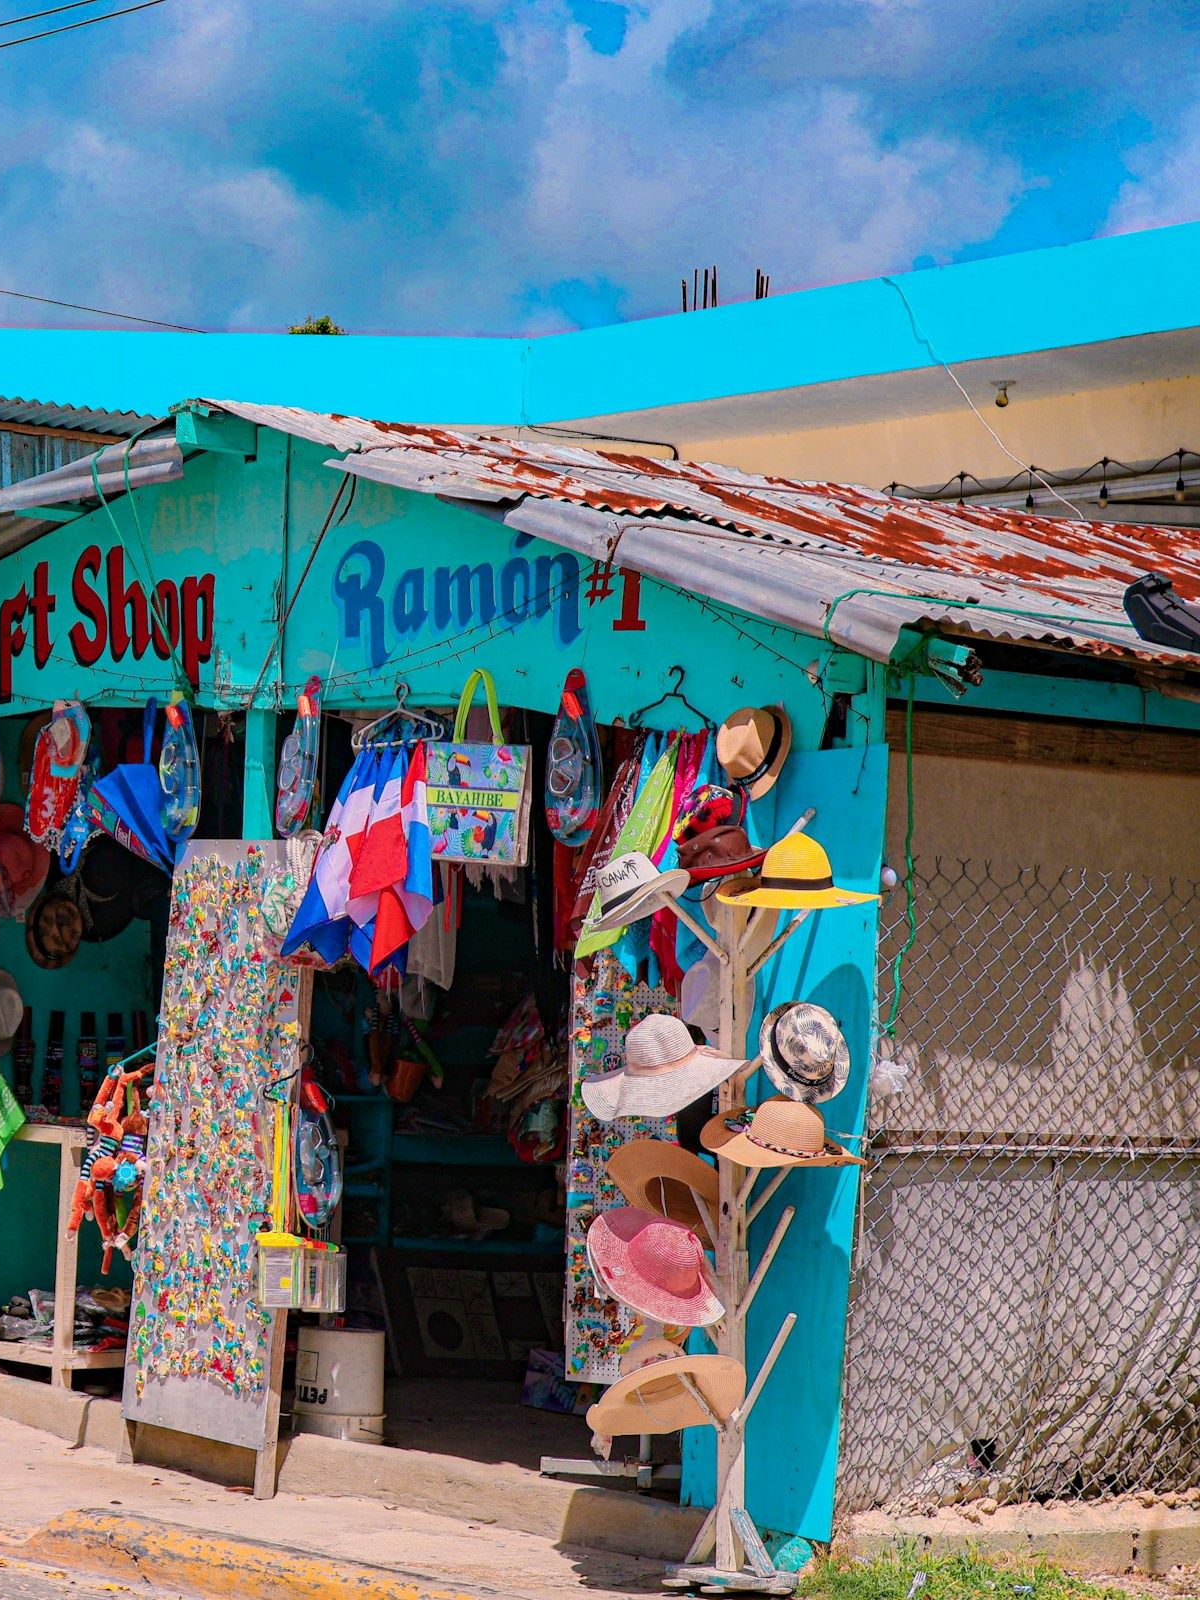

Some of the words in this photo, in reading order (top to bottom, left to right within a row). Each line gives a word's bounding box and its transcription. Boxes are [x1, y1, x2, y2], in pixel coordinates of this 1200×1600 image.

[584, 560, 646, 631] #1
[69, 545, 216, 693] Shop
[436, 789, 503, 807] BAYAHIBE
[601, 869, 629, 888] CANA
